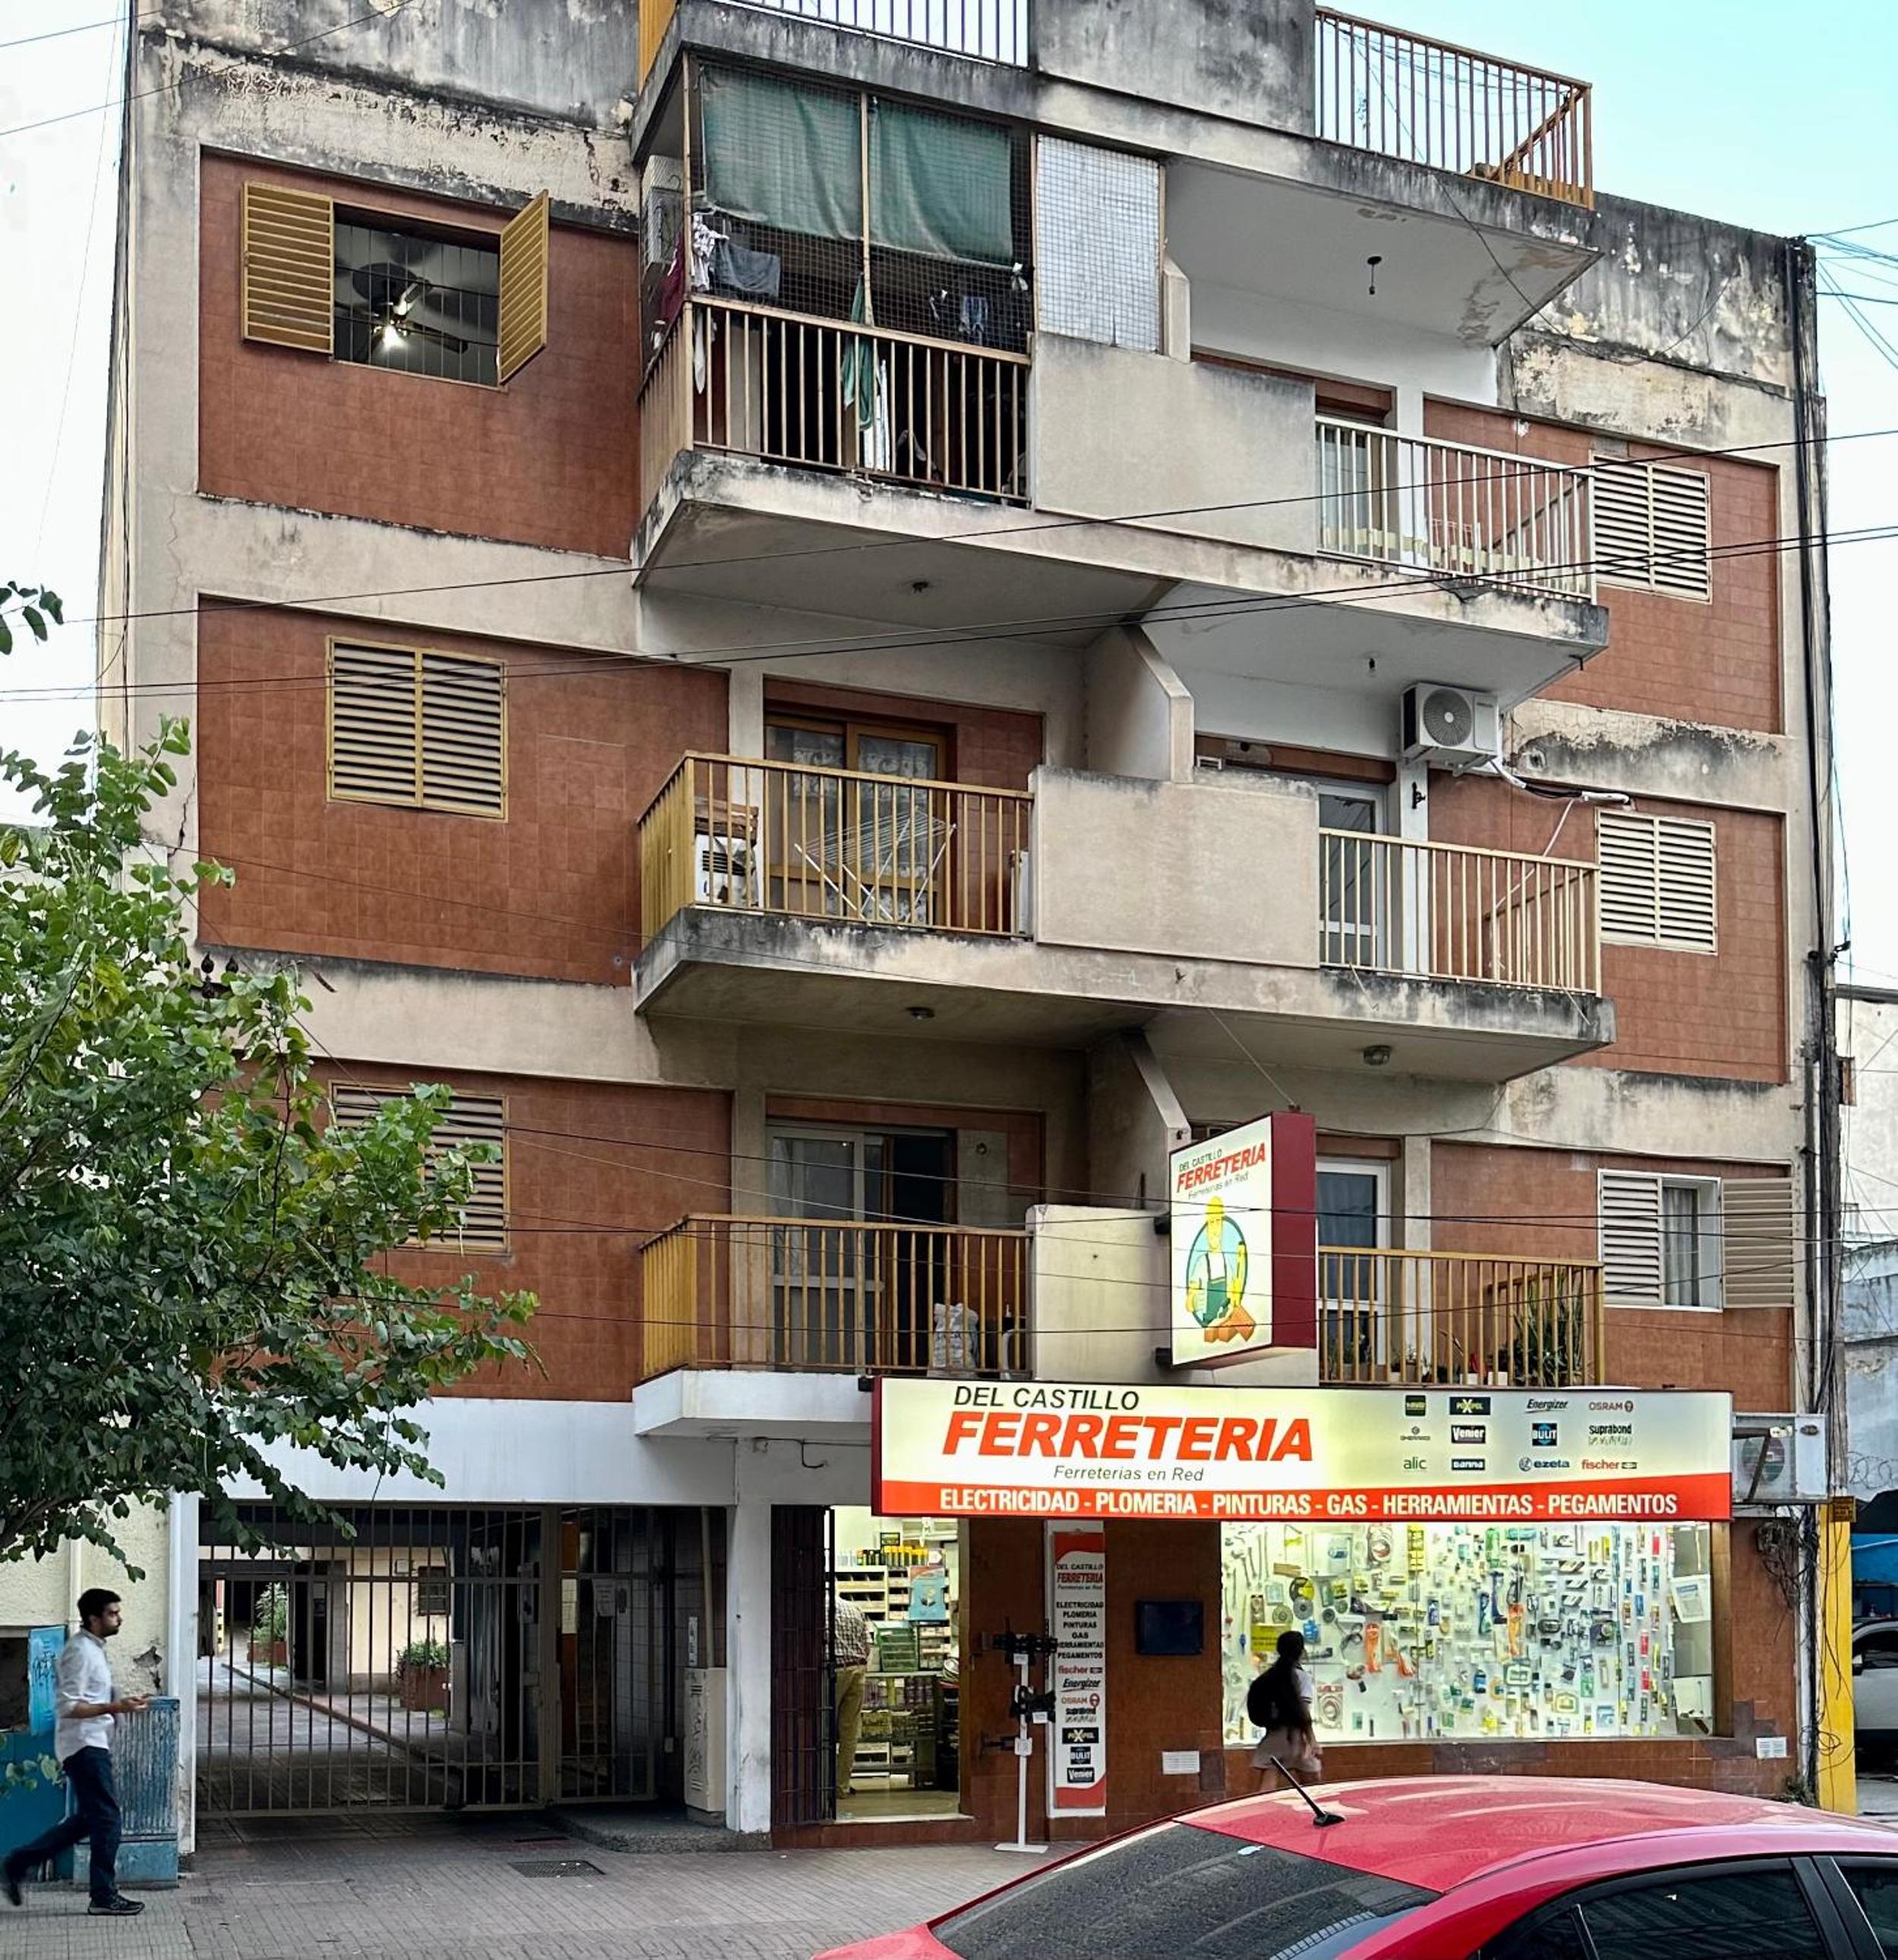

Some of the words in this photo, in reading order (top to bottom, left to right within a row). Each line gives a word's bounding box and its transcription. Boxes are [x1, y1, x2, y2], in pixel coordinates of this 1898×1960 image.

[1176, 1141, 1266, 1194] FERRETERIA
[1178, 1160, 1190, 1173] DEL
[954, 1386, 1004, 1407] DEL
[1013, 1387, 1140, 1410] CASTILLO
[1526, 1399, 1569, 1412] Energizer
[1588, 1402, 1623, 1412] OSRAM
[942, 1412, 1313, 1463] FERRETERIA
[1452, 1427, 1485, 1441] Venier
[1403, 1457, 1427, 1470] alic
[1533, 1459, 1570, 1469] ezeta
[1581, 1460, 1620, 1470] fischer
[1053, 1464, 1142, 1481] Ferreterias
[1147, 1469, 1167, 1482] en
[1171, 1466, 1204, 1482] Red
[940, 1488, 1079, 1513] ELECTRICIDAD
[1096, 1491, 1197, 1514] PLOMERIA
[1212, 1492, 1311, 1515] PINTURAS
[1327, 1493, 1367, 1515] GAS
[1383, 1493, 1534, 1516] HERRAMIENTAS
[1548, 1493, 1678, 1515] PEGAMENTOS
[1057, 1573, 1103, 1583] FERRETERIA
[1058, 1665, 1089, 1674] fischer
[1063, 1678, 1101, 1690] Energizer
[1070, 1751, 1091, 1760] BULIT
[1067, 1769, 1093, 1781] Venier
